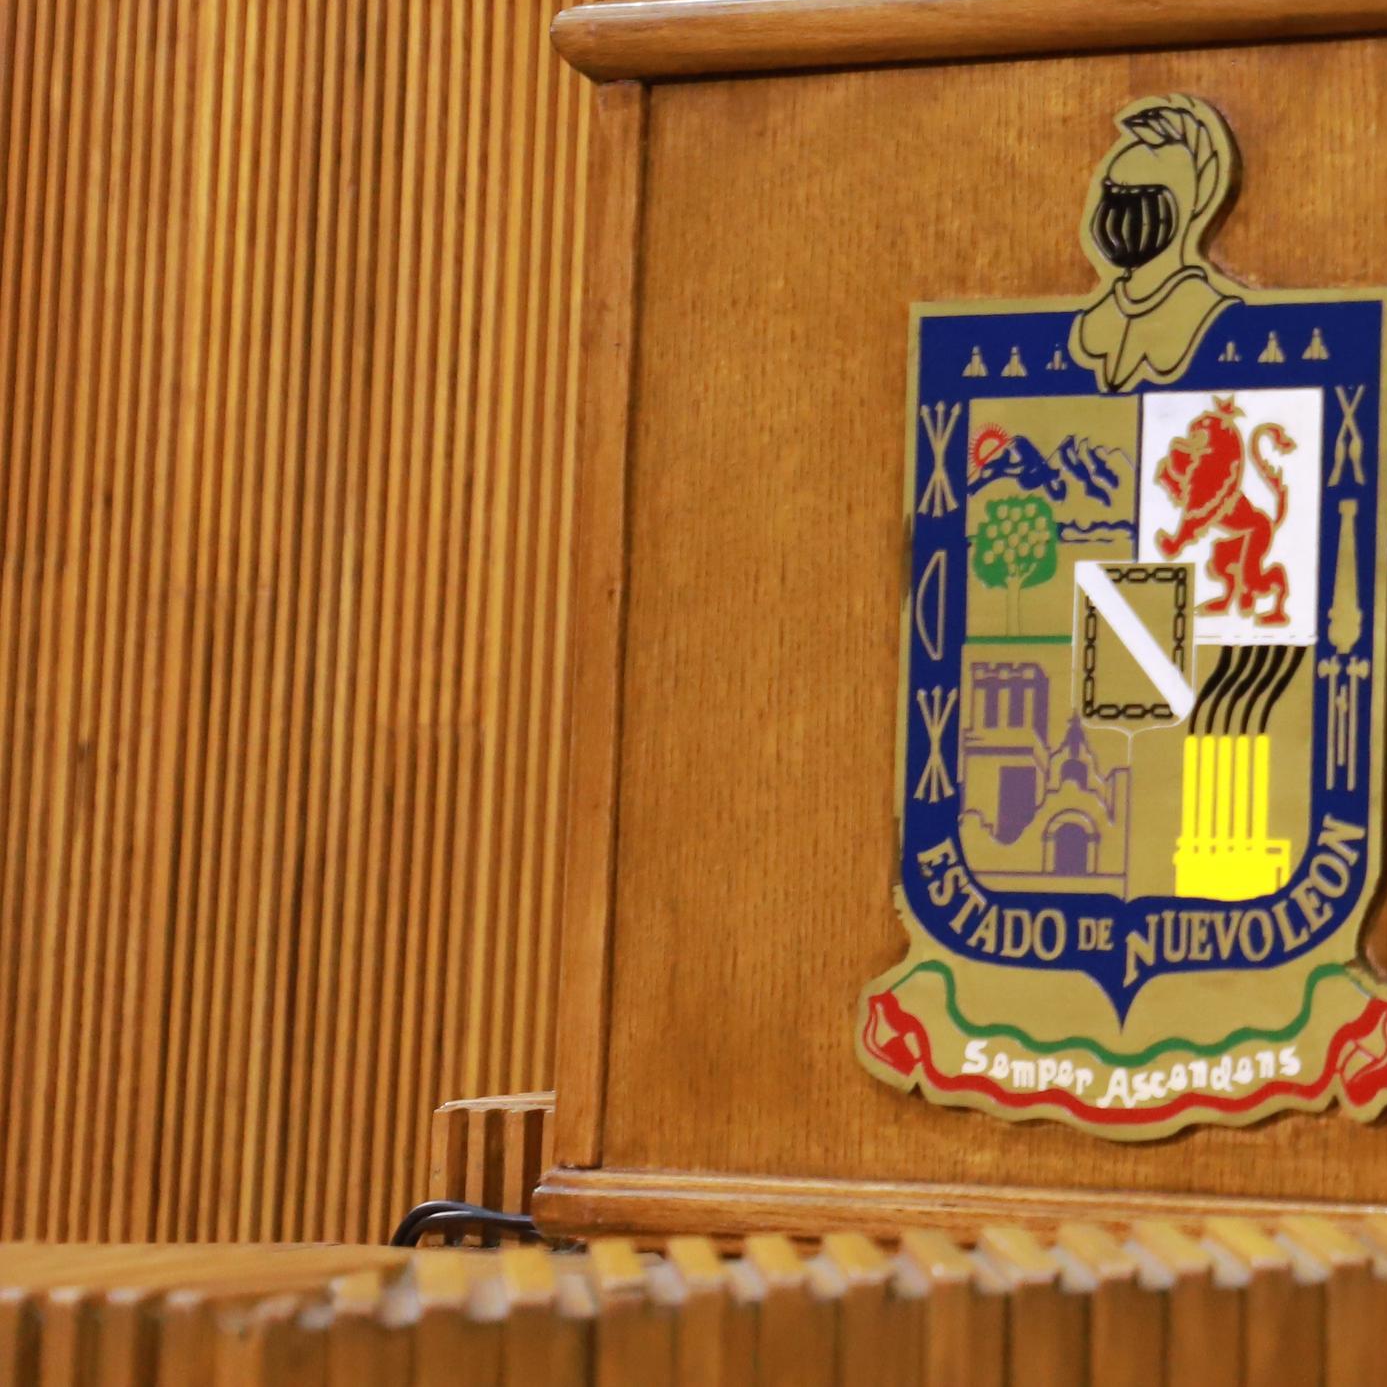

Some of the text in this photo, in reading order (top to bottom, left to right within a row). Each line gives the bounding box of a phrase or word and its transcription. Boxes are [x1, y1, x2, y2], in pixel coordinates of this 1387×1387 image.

[917, 837, 1067, 961] ESTADO
[1077, 917, 1115, 952] DE
[961, 1039, 1302, 1109] Semper Ascendens
